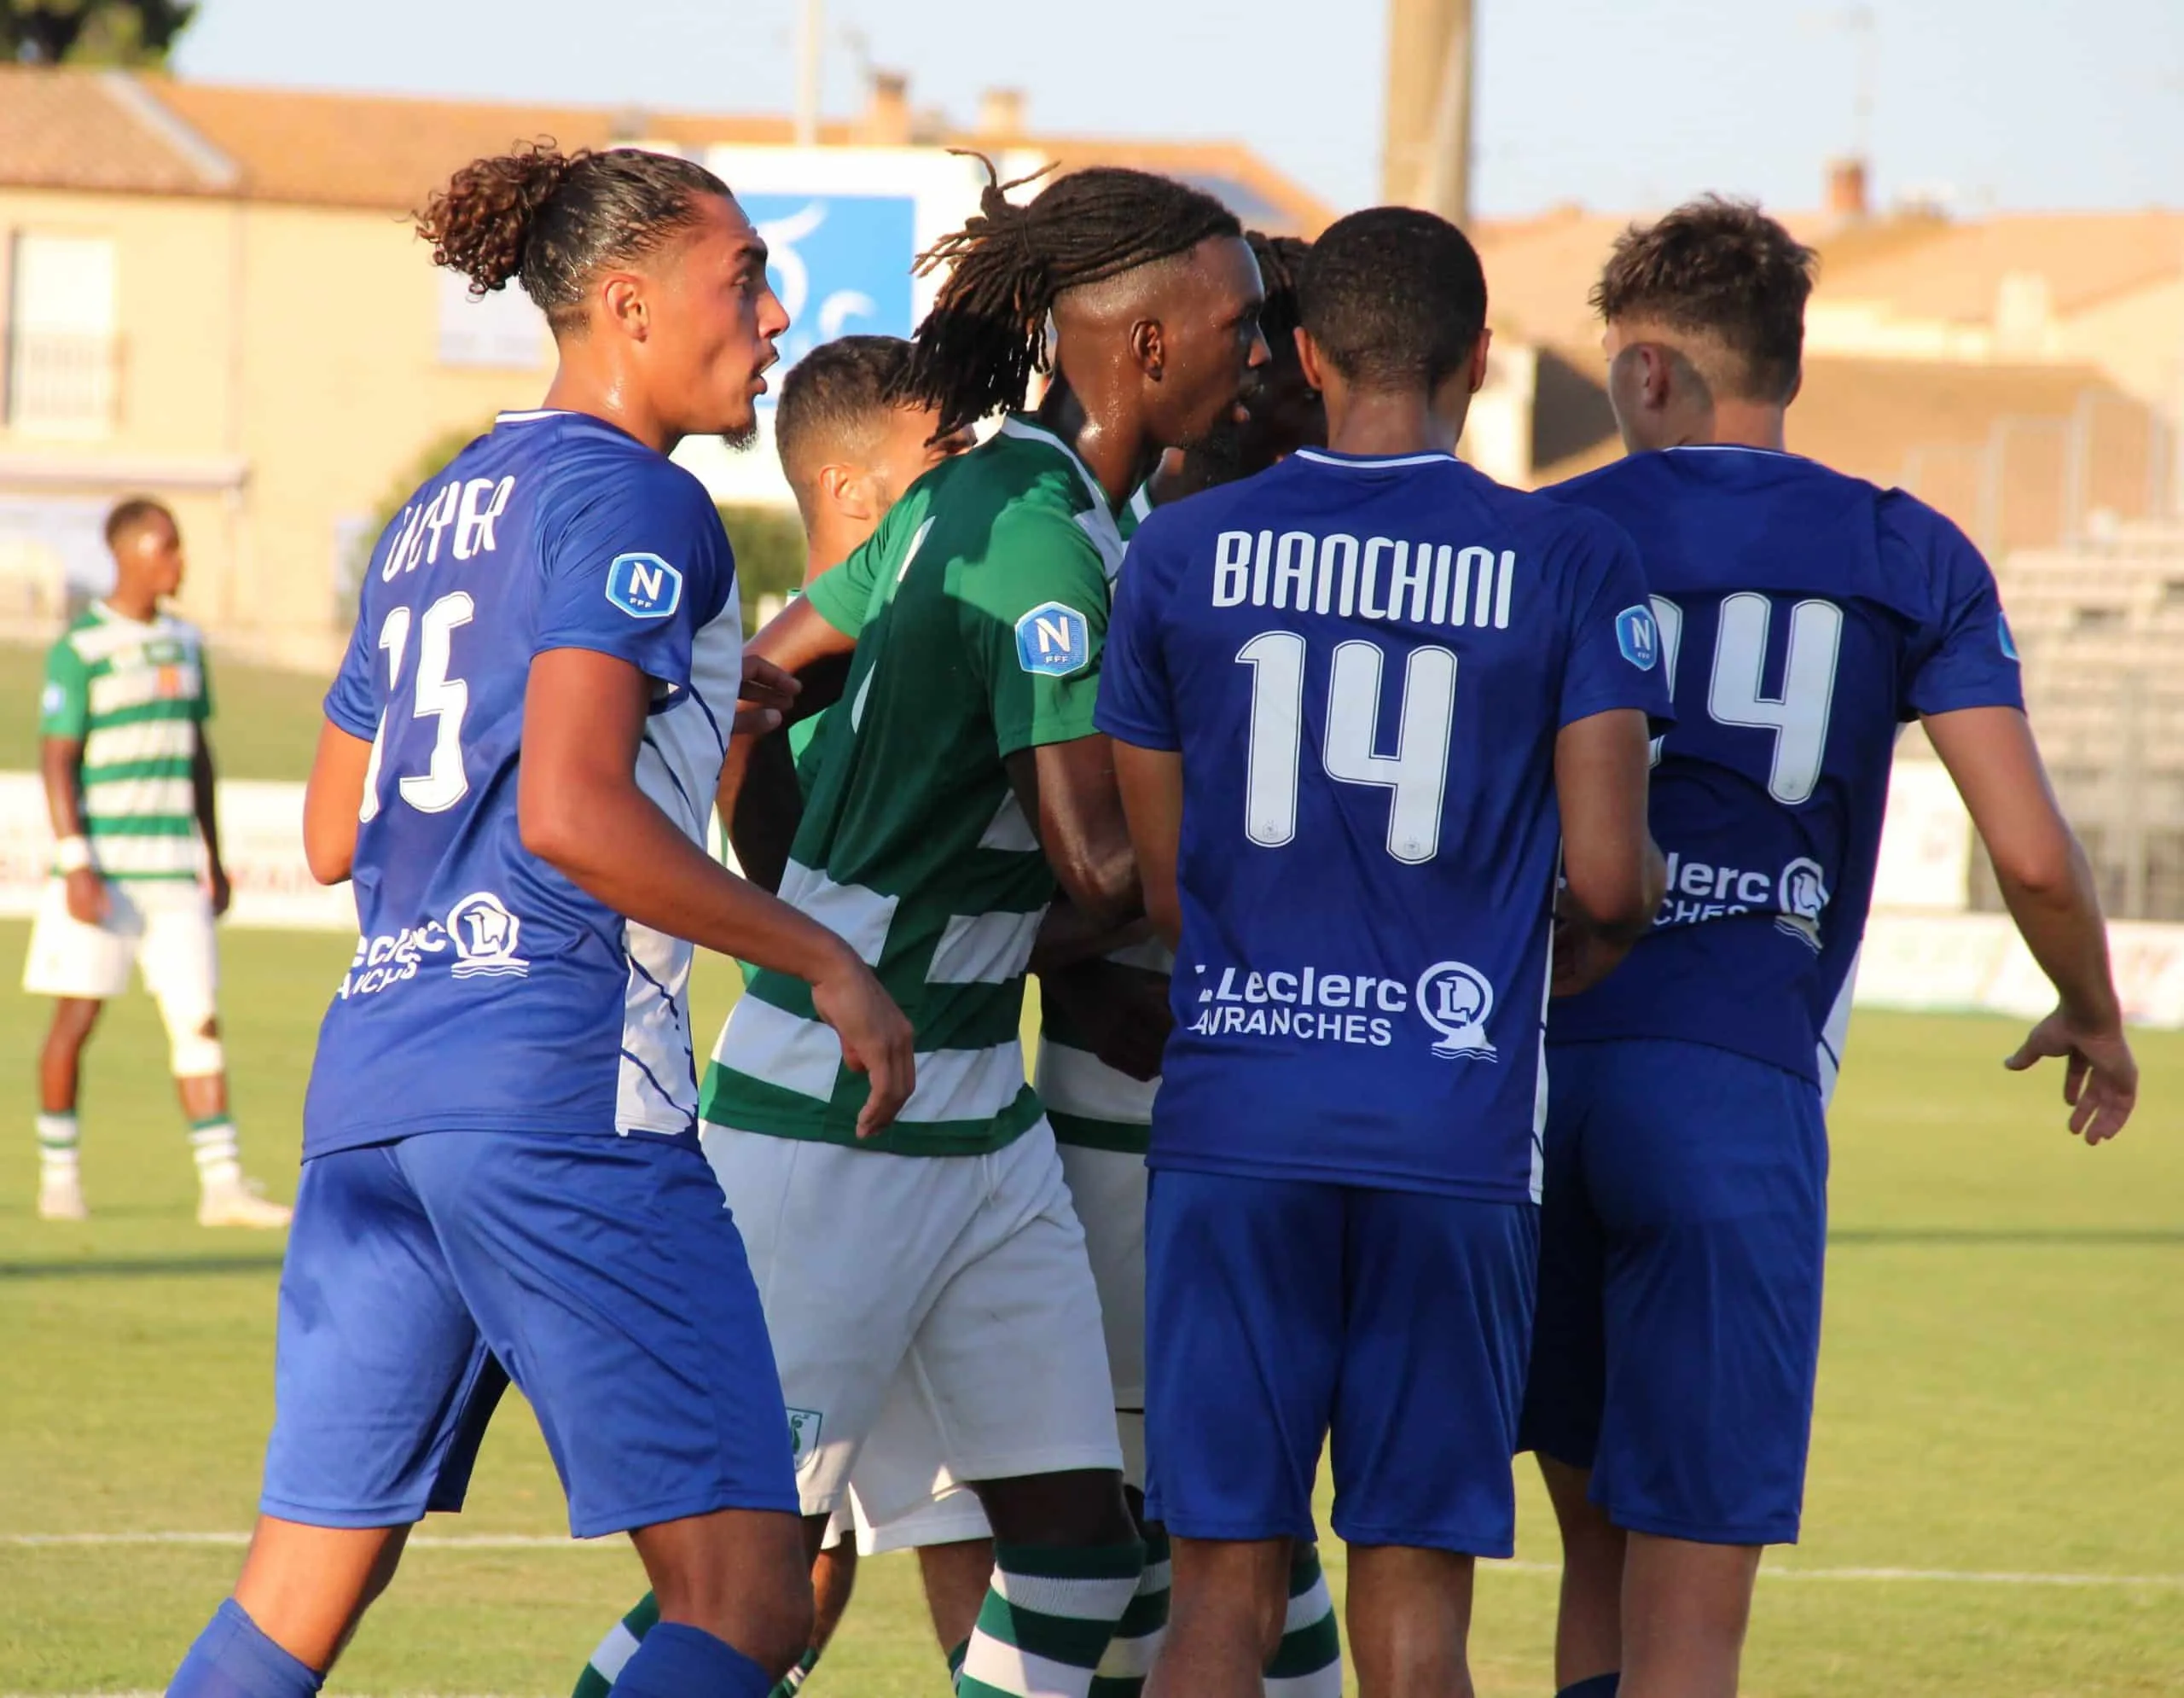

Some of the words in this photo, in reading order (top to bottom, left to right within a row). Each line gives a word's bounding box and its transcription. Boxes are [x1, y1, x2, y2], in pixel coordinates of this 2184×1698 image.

[629, 561, 663, 601] N
[1211, 530, 1516, 630] BIANCHINI
[1035, 615, 1072, 653] N
[1630, 616, 1651, 651] N
[1044, 654, 1069, 664] FFF
[359, 590, 474, 823] 15
[1234, 630, 1458, 865] 14
[1186, 1005, 1392, 1047] AVRANCHES
